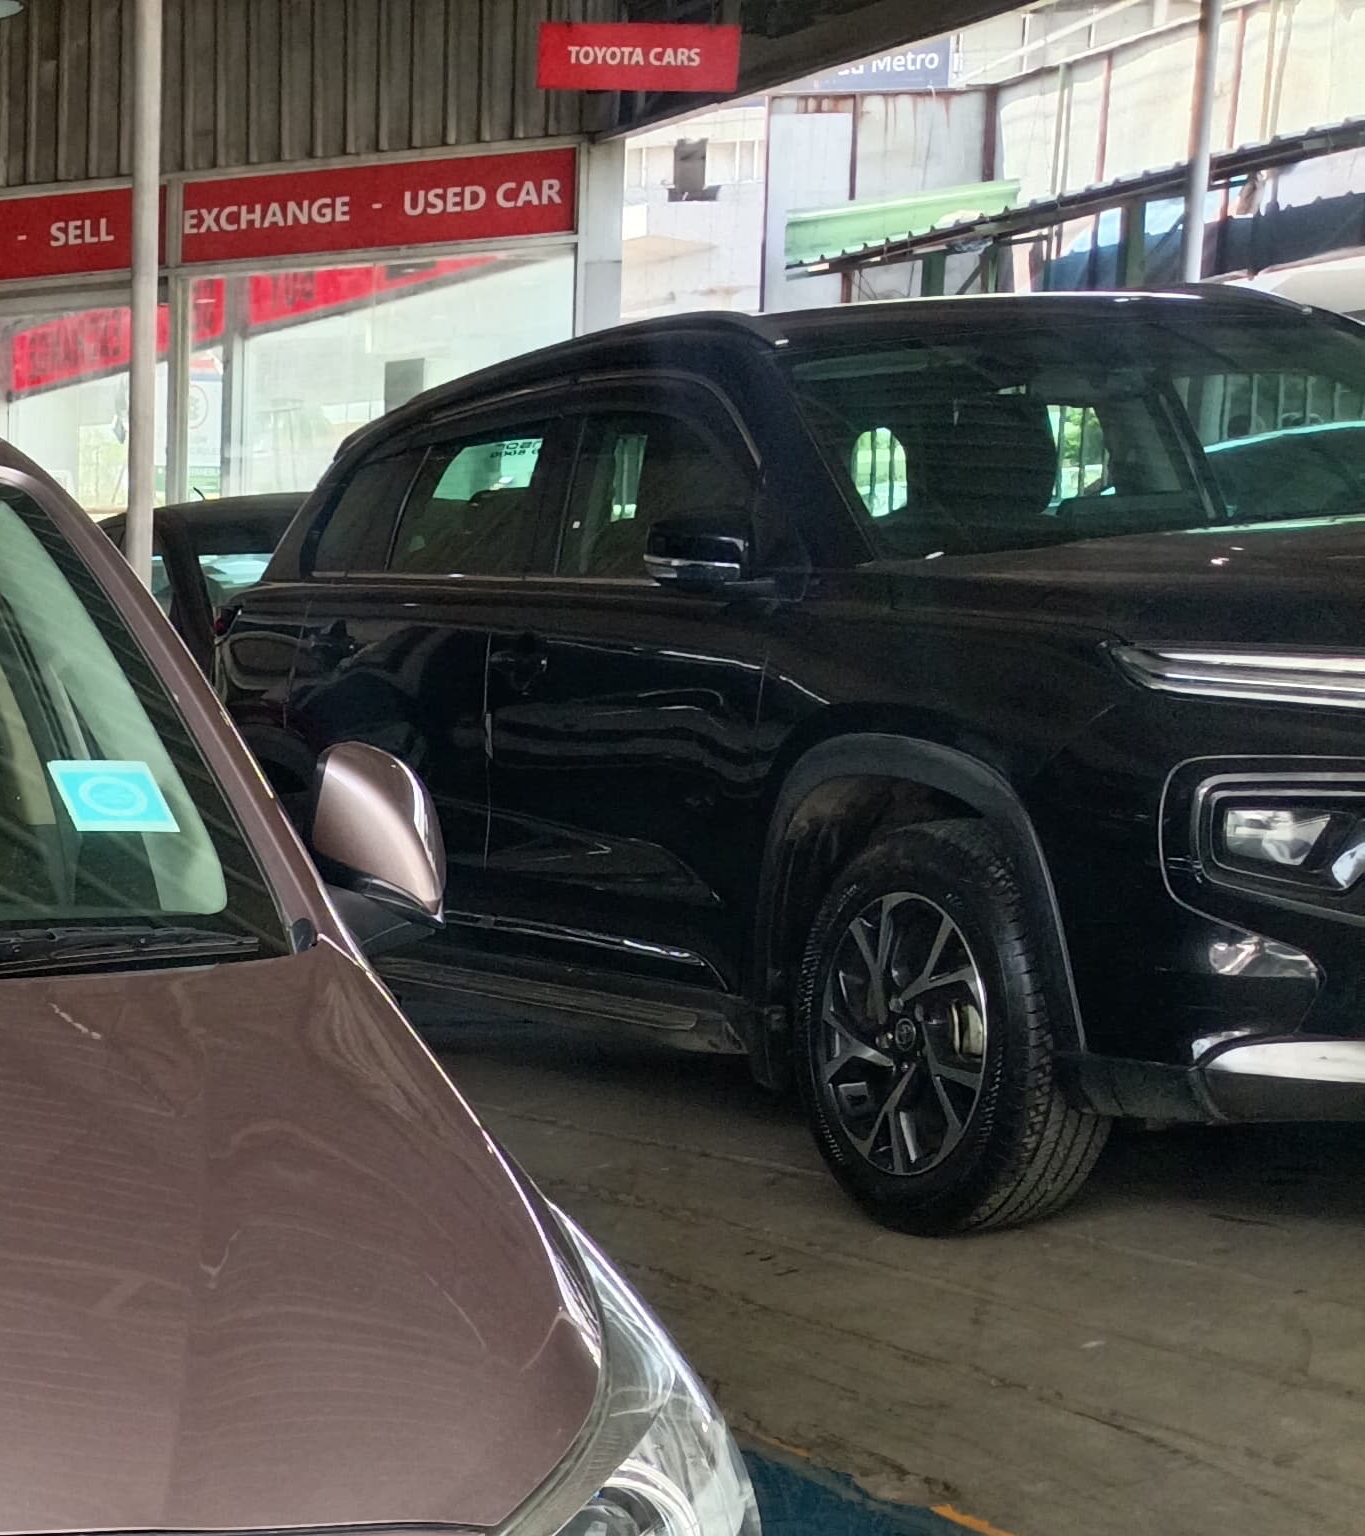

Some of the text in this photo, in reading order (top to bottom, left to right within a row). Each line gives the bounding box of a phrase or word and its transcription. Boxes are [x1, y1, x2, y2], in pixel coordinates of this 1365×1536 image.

[568, 46, 701, 67] TOYOTA CARS
[872, 52, 939, 73] Metro
[183, 195, 350, 234] EXCHANGE
[404, 185, 486, 216] USED
[496, 179, 562, 208] CAR
[50, 217, 115, 247] SELL
